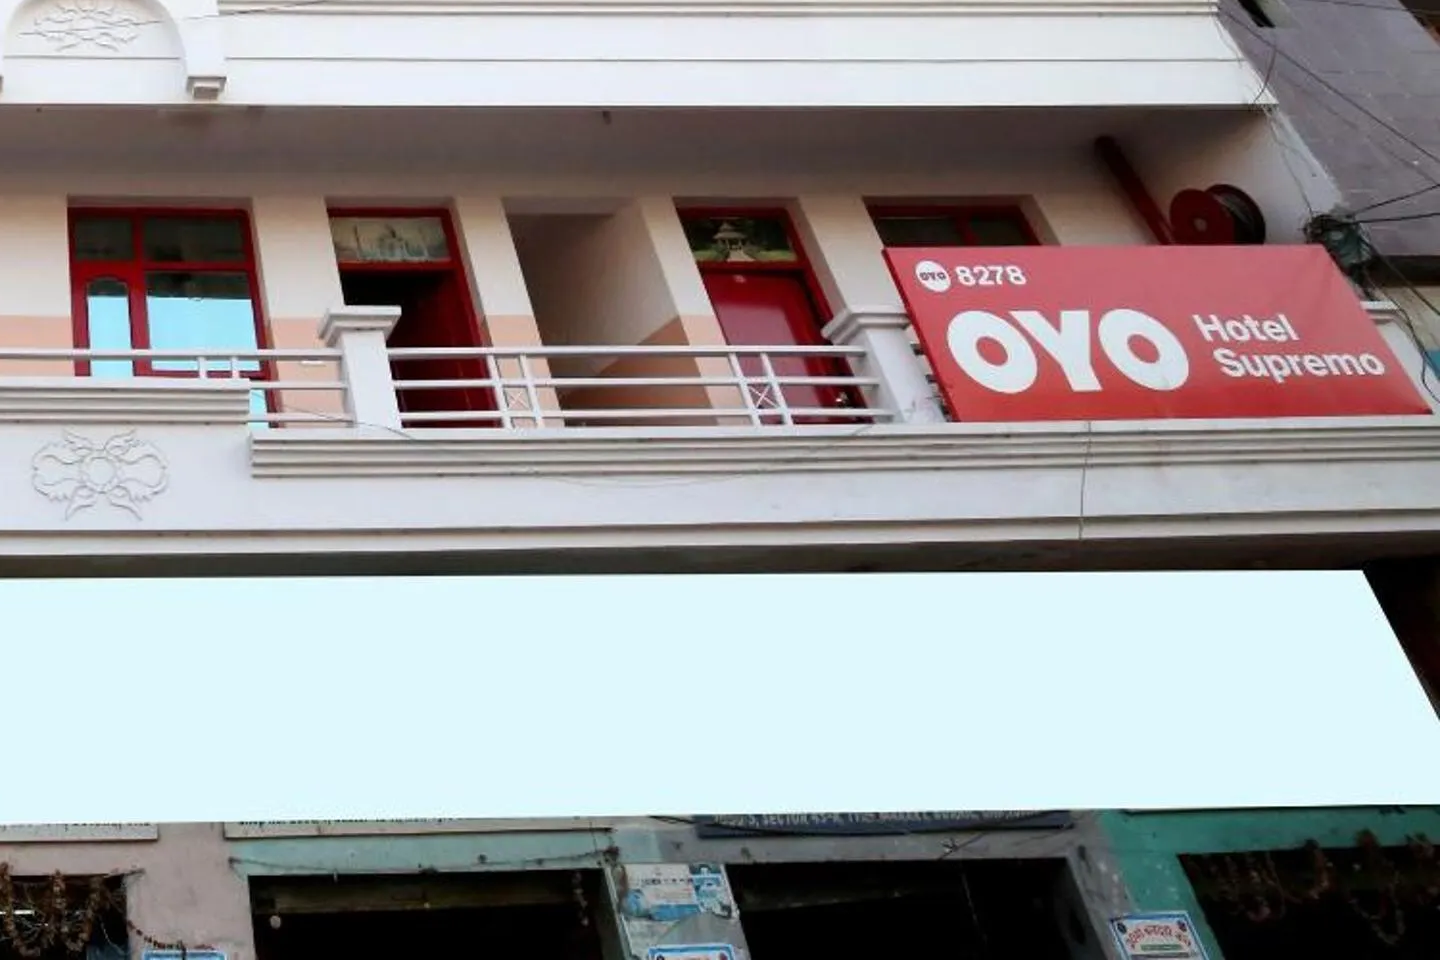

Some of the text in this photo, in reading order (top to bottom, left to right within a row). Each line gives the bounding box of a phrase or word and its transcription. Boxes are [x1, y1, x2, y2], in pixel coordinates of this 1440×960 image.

[955, 265, 1027, 286] 8278
[1192, 313, 1300, 343] Hotel
[946, 308, 1190, 394] OYO
[1212, 347, 1387, 384] Supremo
